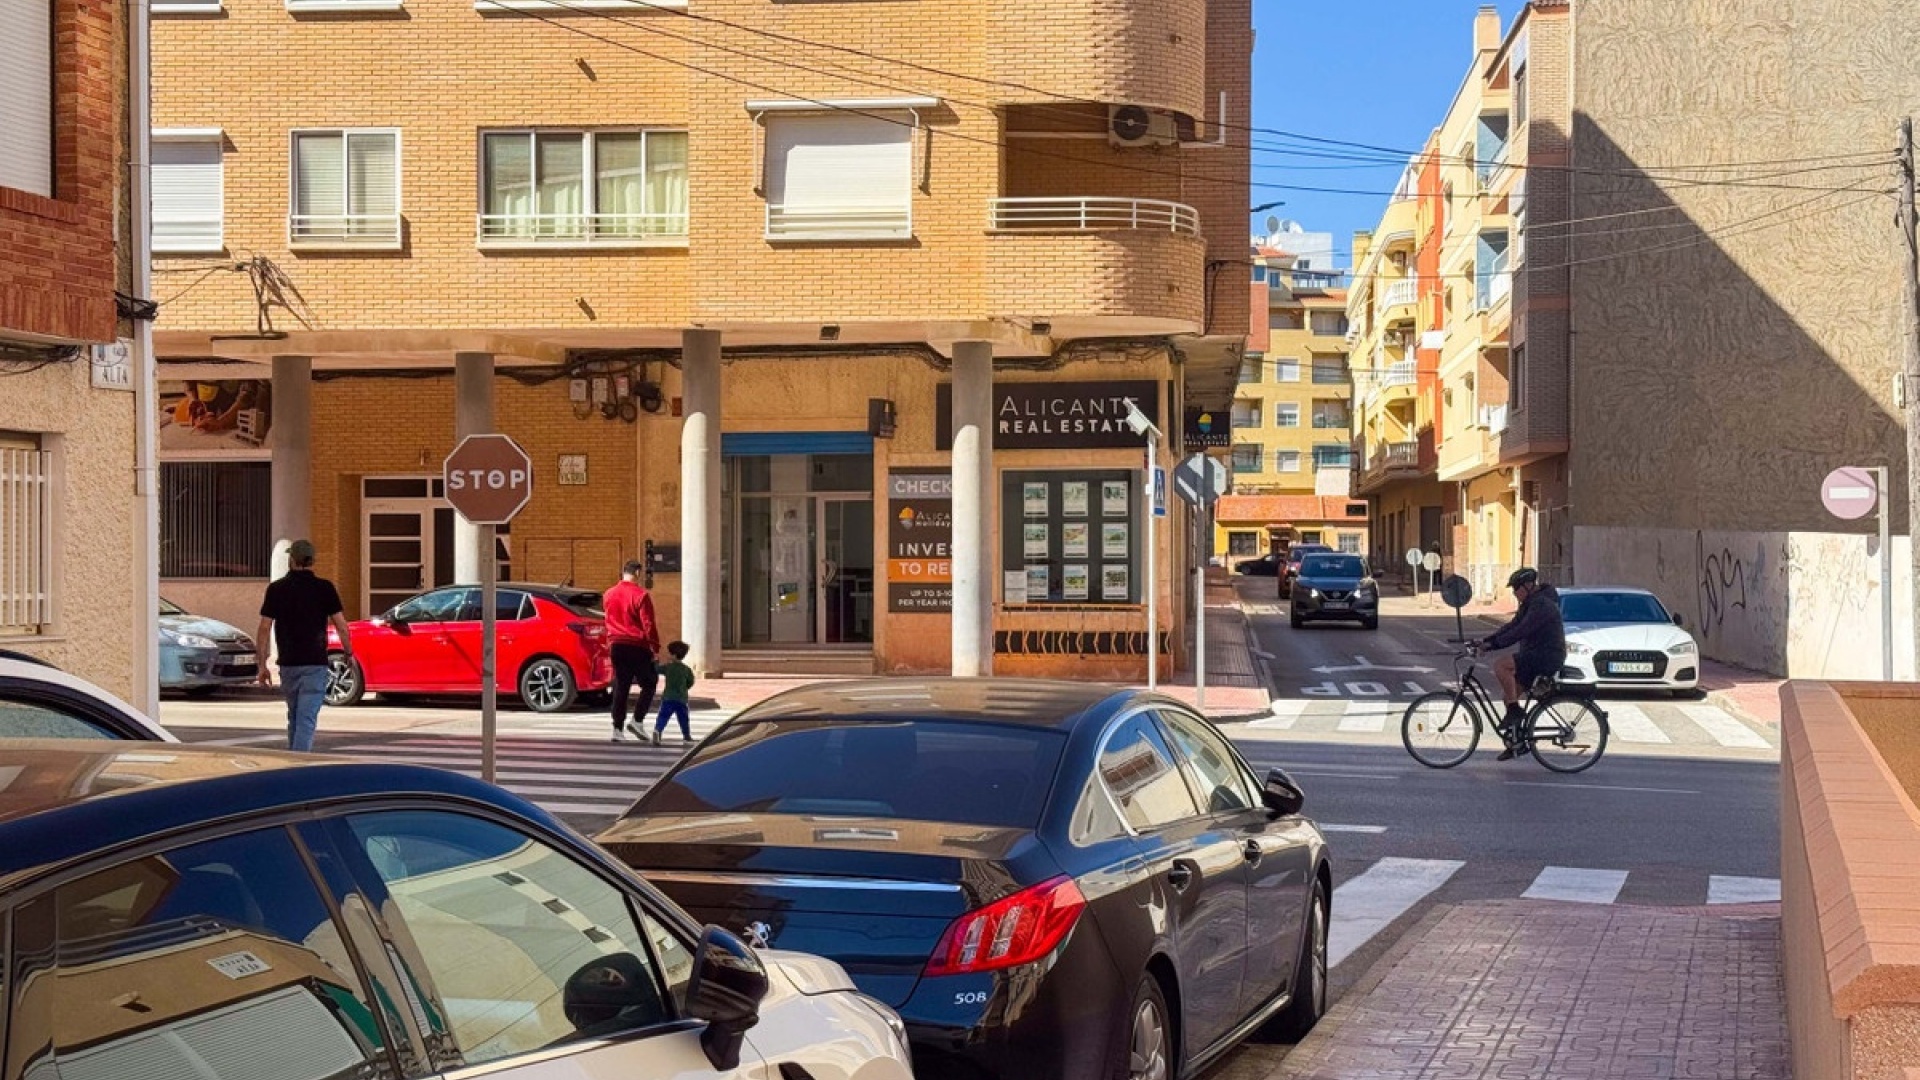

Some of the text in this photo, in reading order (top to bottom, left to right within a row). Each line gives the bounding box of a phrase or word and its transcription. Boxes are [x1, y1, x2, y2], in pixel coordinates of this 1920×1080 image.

[102, 366, 129, 384] ALTA
[999, 419, 1139, 434] REAL ESTAT
[449, 469, 526, 490] STOP
[895, 480, 953, 493] CHECK
[898, 542, 953, 557] INVE
[898, 561, 953, 576] TO RE
[923, 588, 935, 597] TO
[898, 598, 914, 606] PER
[953, 991, 987, 1005] 508
